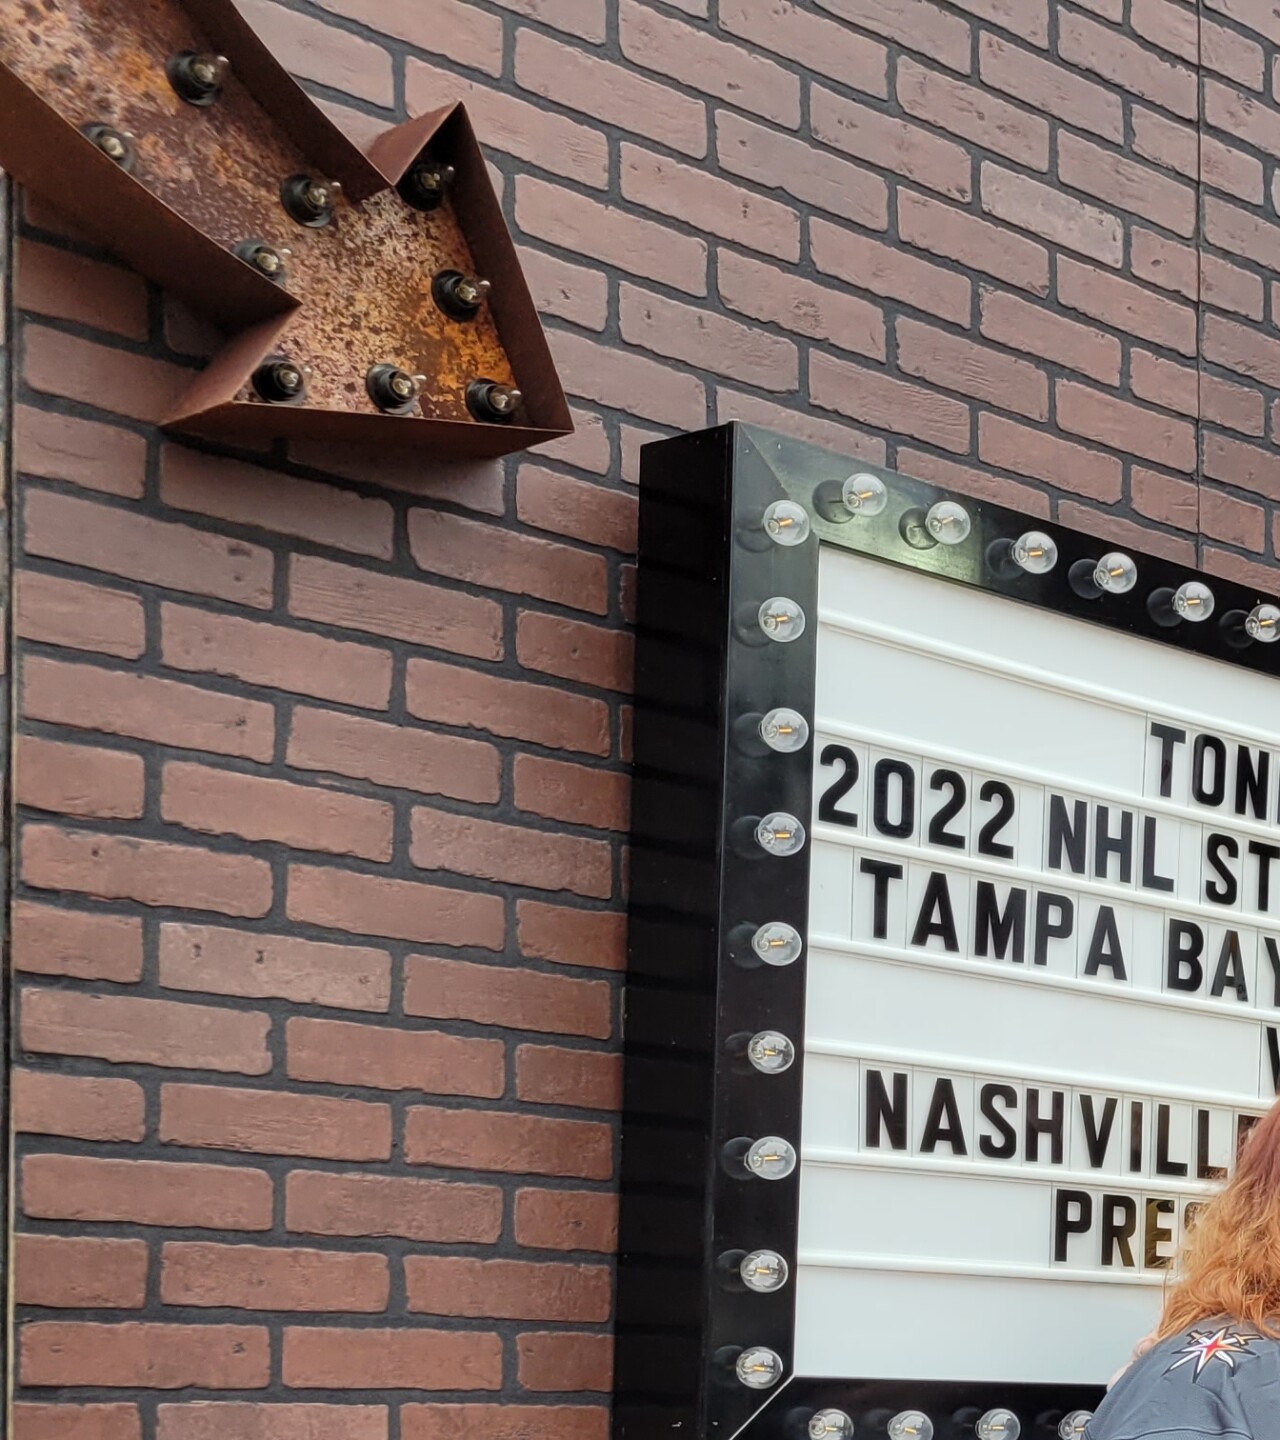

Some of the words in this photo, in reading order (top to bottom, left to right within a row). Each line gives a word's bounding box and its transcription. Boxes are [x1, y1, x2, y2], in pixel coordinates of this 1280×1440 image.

[818, 743, 1016, 860] 2022
[1047, 794, 1175, 893] NHL
[860, 857, 1128, 981] TAMPA
[1055, 1188, 1210, 1268] PRE
